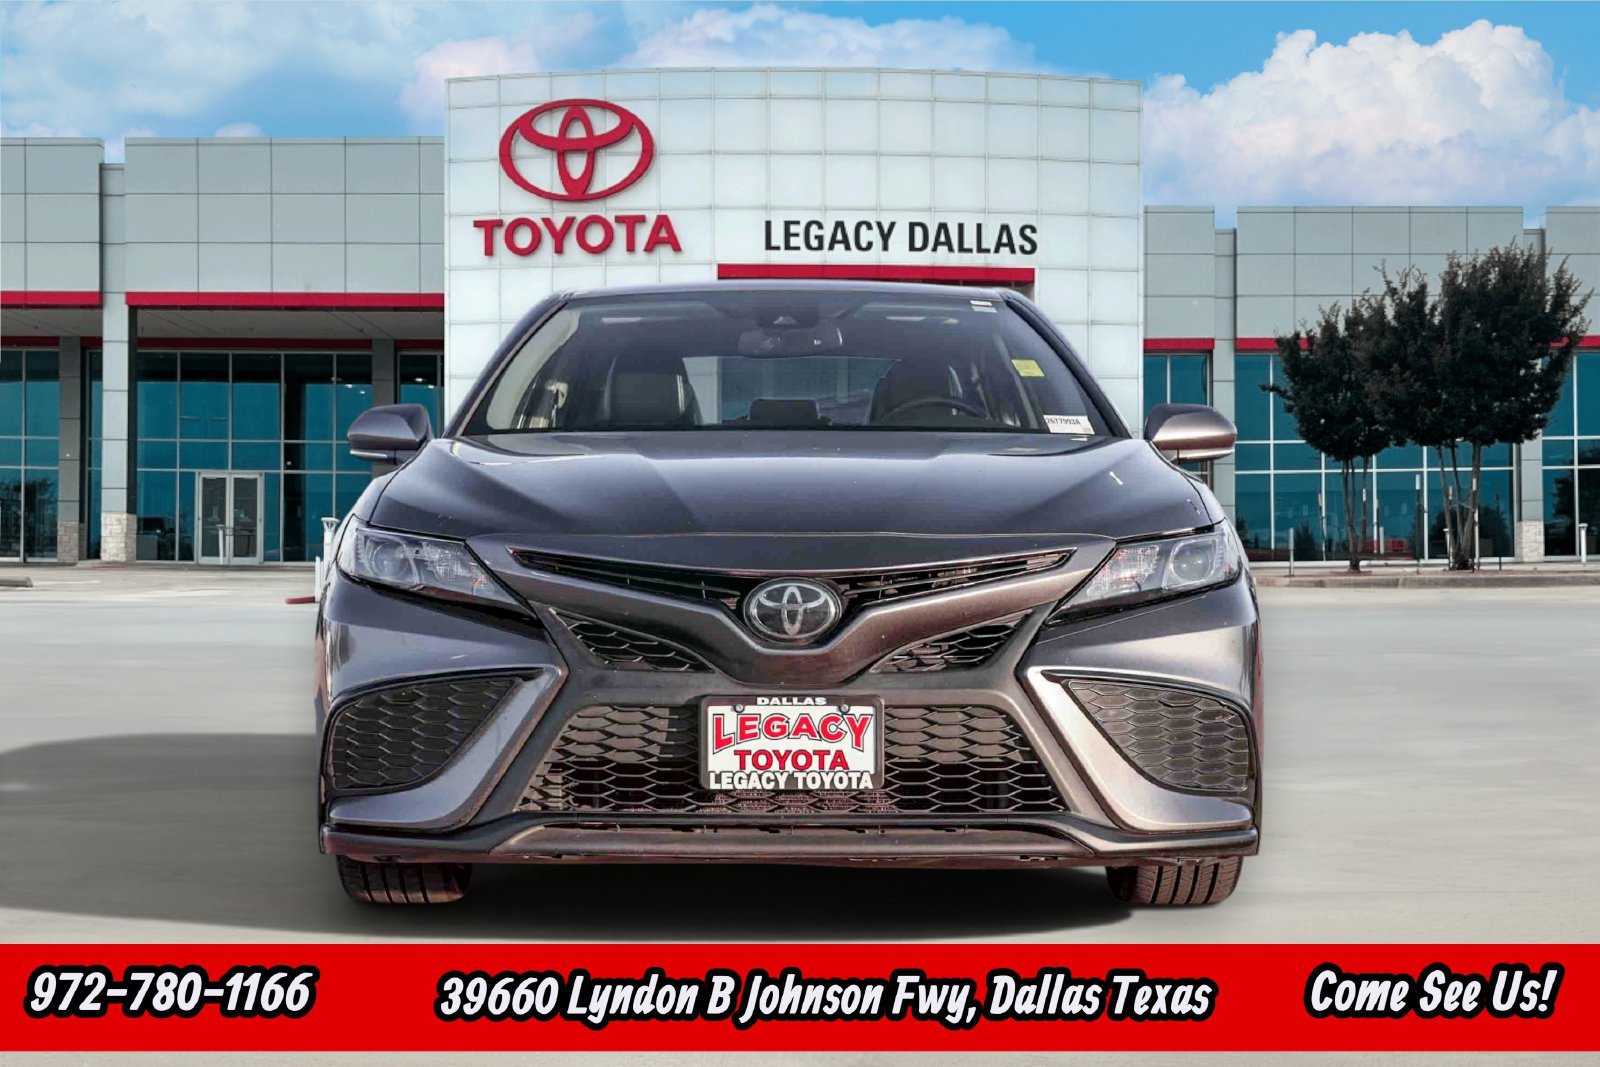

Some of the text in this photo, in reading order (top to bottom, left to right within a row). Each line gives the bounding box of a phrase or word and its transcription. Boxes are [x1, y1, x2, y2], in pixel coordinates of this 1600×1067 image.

[473, 214, 682, 256] TOYOTA
[764, 219, 1038, 256] LEGACY DALLAS
[756, 696, 827, 706] DALLAS
[712, 712, 874, 755] LEGACY
[733, 749, 850, 771] TOYOTA
[709, 771, 874, 790] LEGACY TOYOTA
